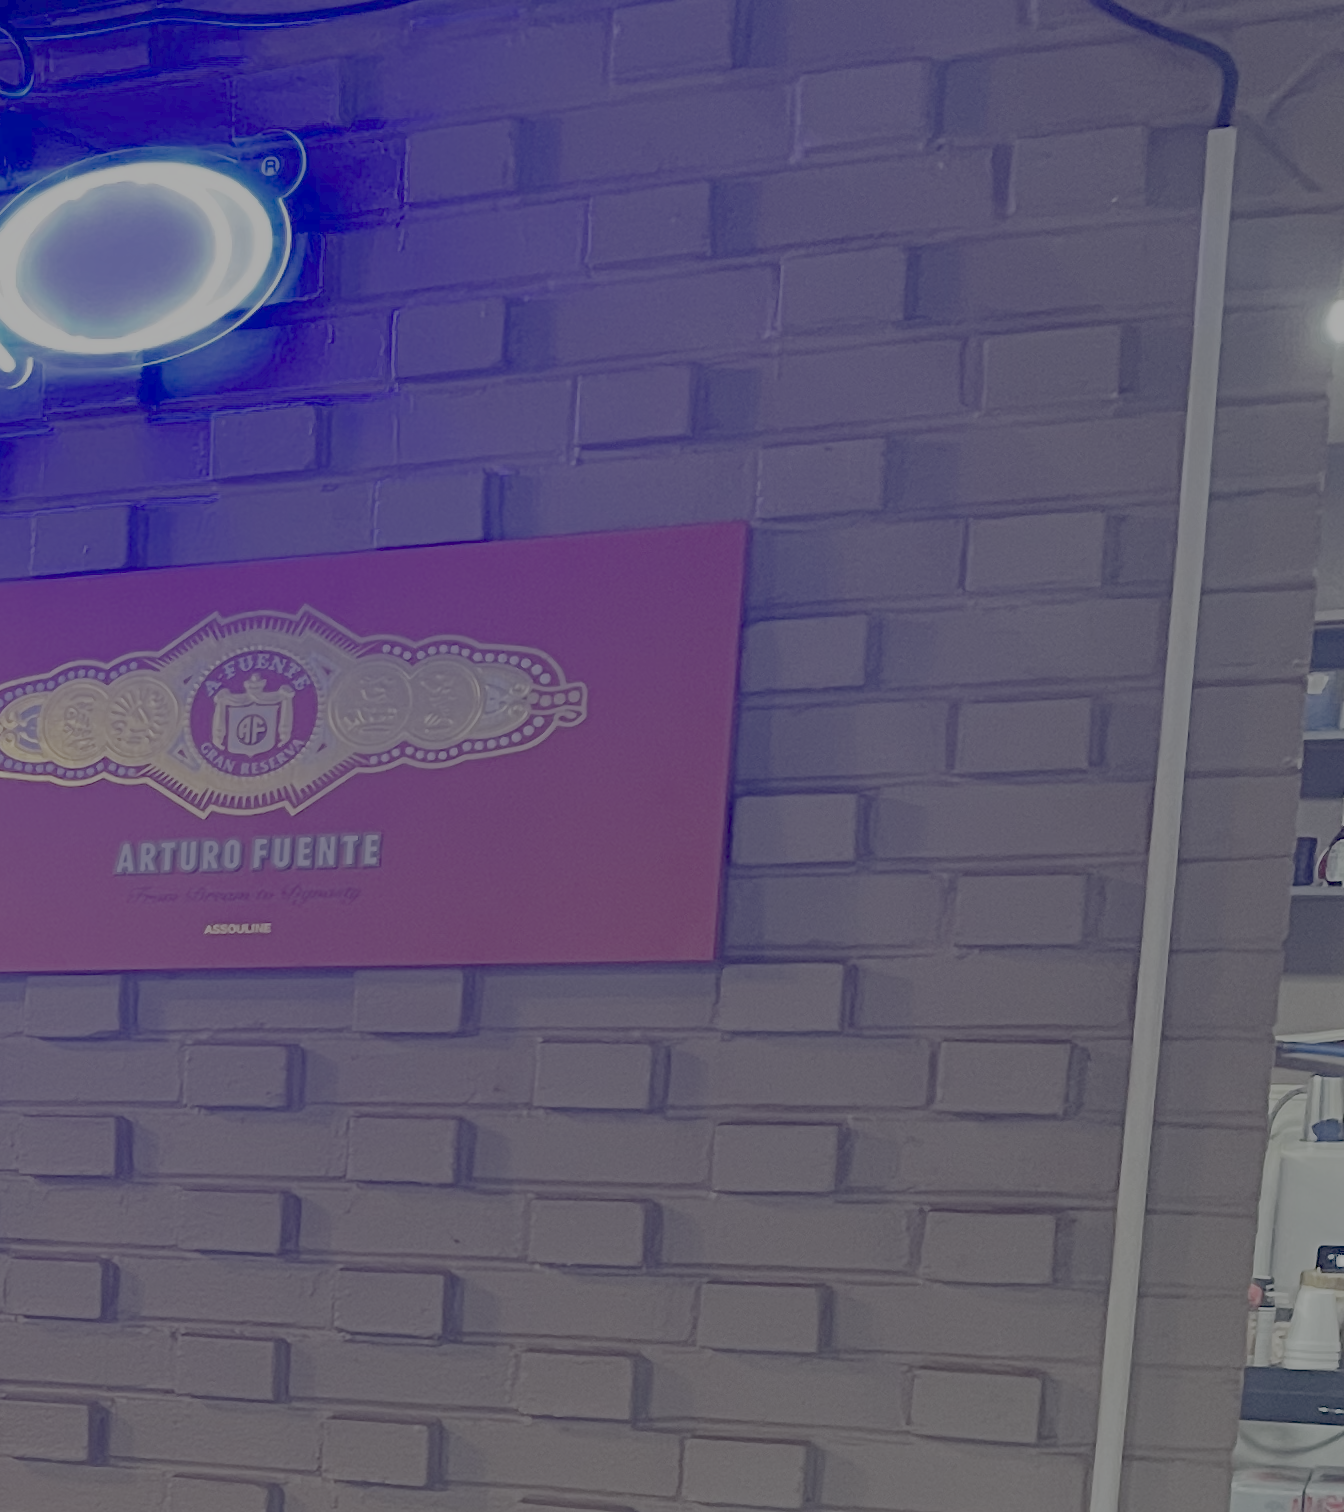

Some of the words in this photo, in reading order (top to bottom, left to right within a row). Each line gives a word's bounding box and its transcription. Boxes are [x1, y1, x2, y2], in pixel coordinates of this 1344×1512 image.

[200, 741, 236, 772] GRAN
[240, 738, 305, 775] RESERVA
[113, 838, 243, 875] ARTURO
[250, 832, 382, 873] FUENTE
[204, 922, 272, 935] ASSOULINE
